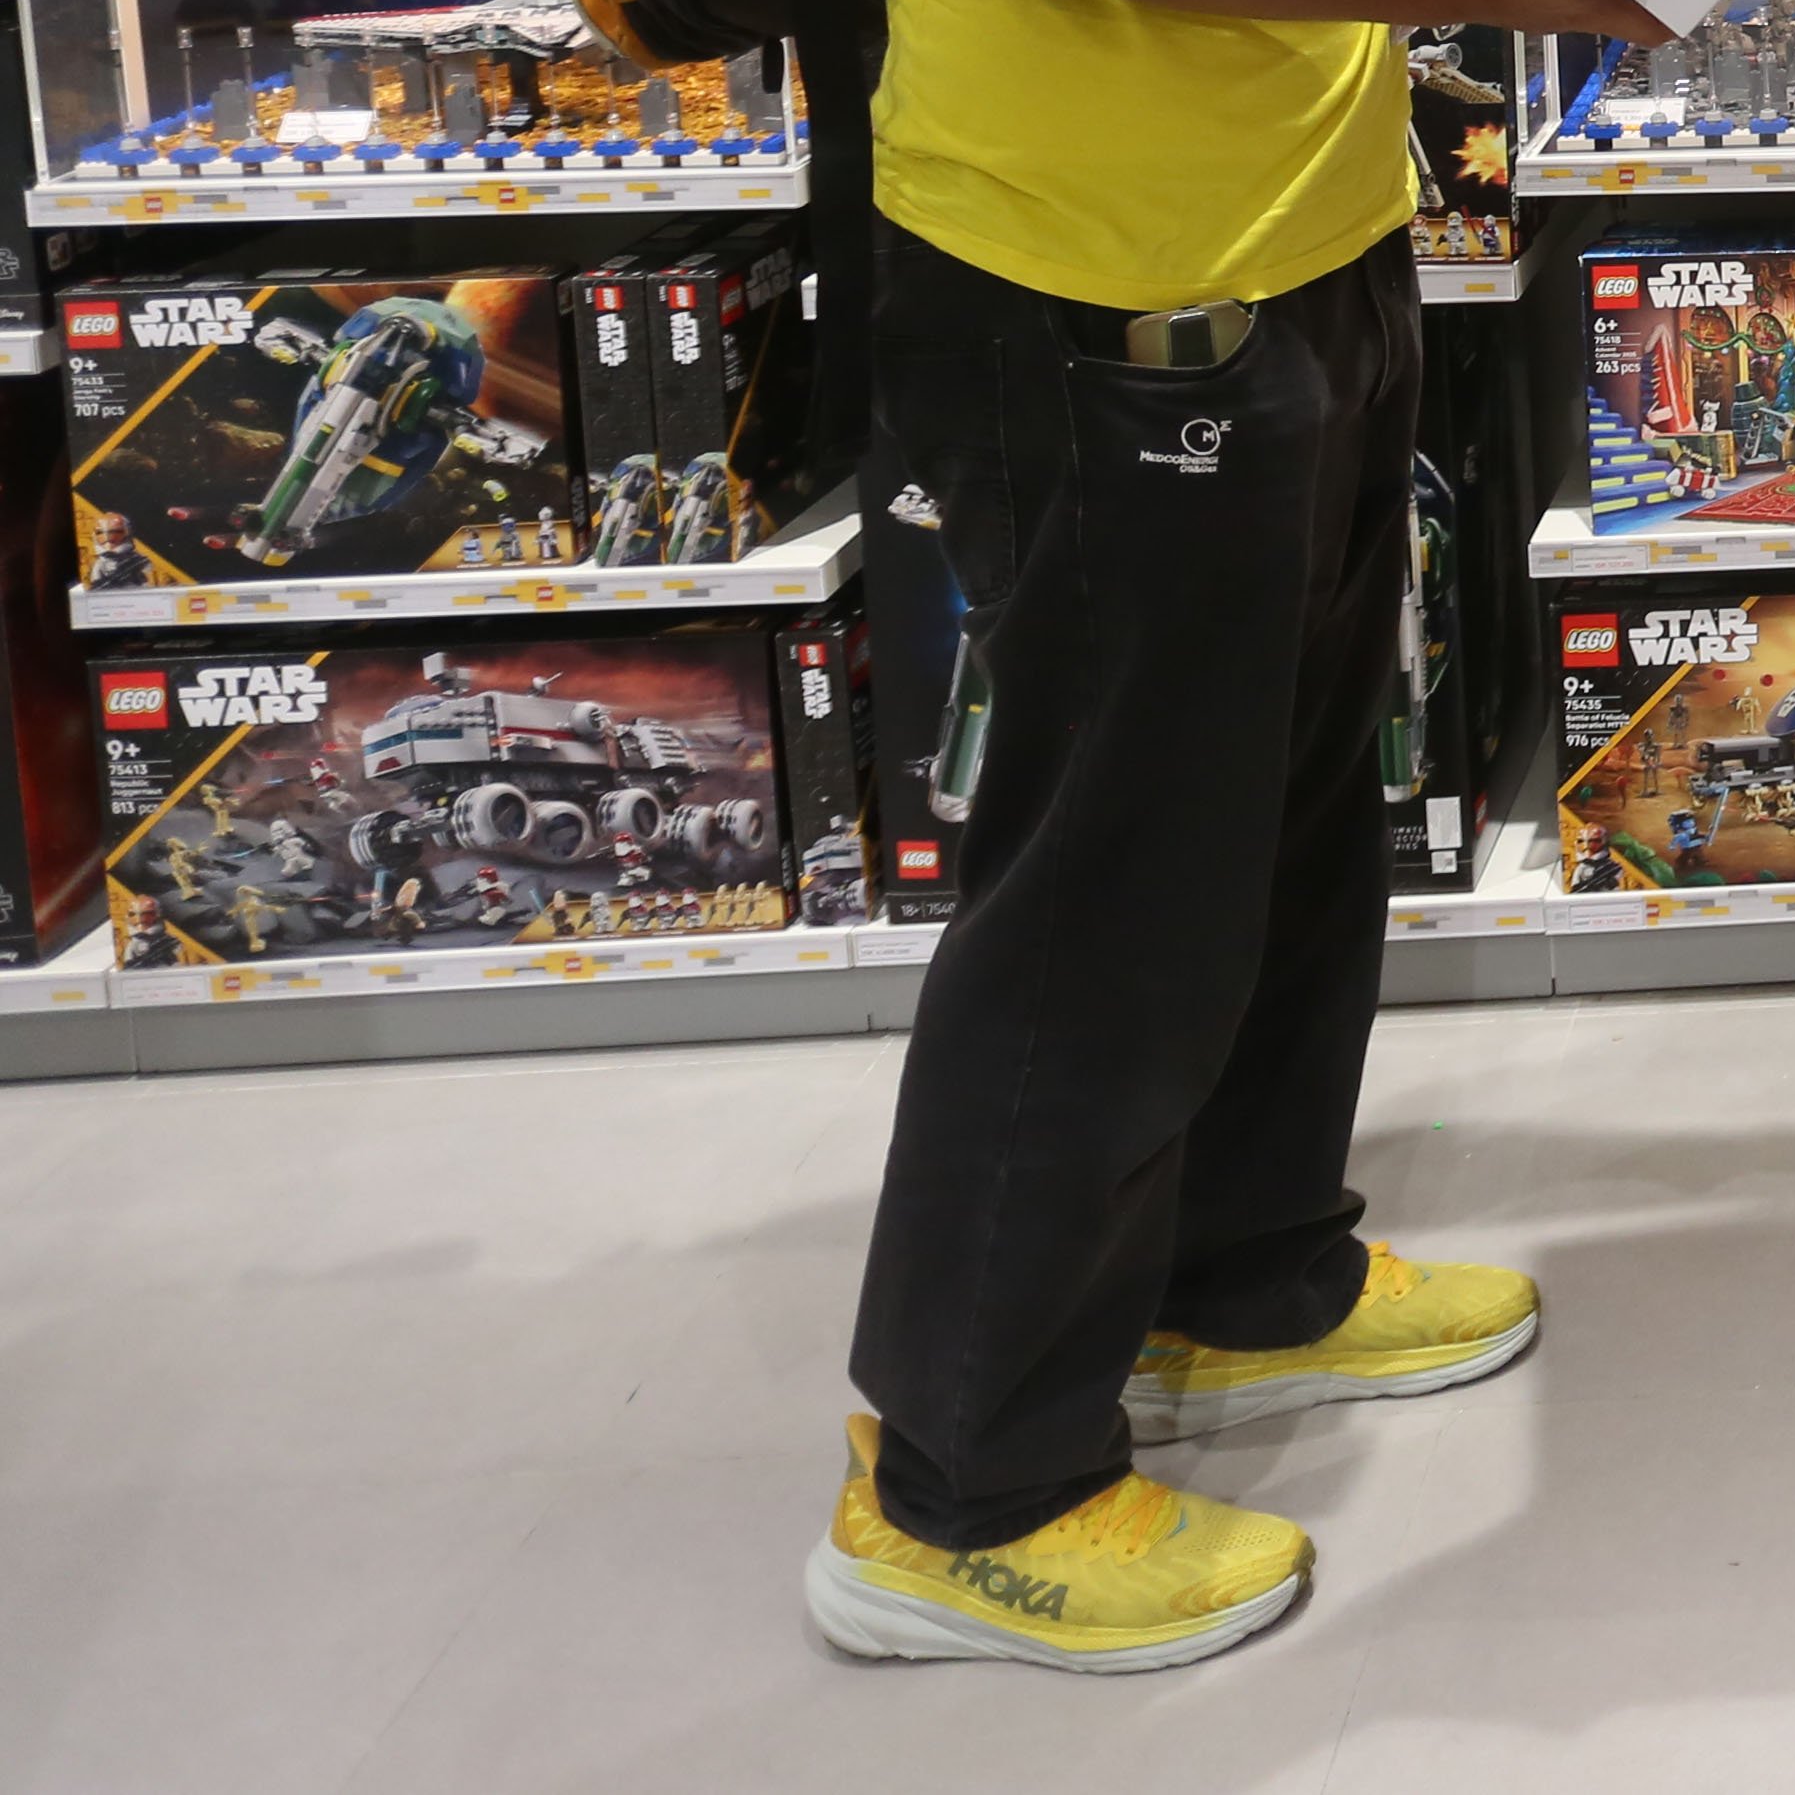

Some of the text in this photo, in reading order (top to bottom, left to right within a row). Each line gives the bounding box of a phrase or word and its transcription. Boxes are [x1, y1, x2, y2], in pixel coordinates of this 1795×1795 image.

[1647, 262, 1753, 285] STAR
[1595, 277, 1637, 297] LEGO
[1647, 283, 1753, 308] WARS
[129, 297, 253, 322] STAR
[69, 315, 118, 336] LEGO
[129, 320, 253, 348] WARS
[1594, 317, 1618, 333] 6+
[1594, 336, 1621, 344] 75418
[69, 357, 98, 374] 9+
[1595, 361, 1641, 375] 263 pcs
[72, 377, 104, 386] 75433
[75, 404, 126, 419] 707 pcs
[1628, 608, 1758, 639] STAR
[1564, 627, 1617, 653] LEGO
[1628, 635, 1758, 667] WARS
[178, 665, 328, 699] STAR
[1563, 677, 1594, 697] 9+
[107, 688, 164, 714] LEGO
[178, 693, 328, 728] WARS
[1564, 700, 1602, 711] 75435
[105, 740, 141, 761] 9+
[1566, 734, 1610, 748] 976 pcs
[108, 764, 149, 775] 75413
[111, 802, 161, 815] 813 pcs
[901, 850, 938, 868] LEGO
[902, 902, 921, 917] 18+
[945, 1552, 1072, 1622] HOKA
